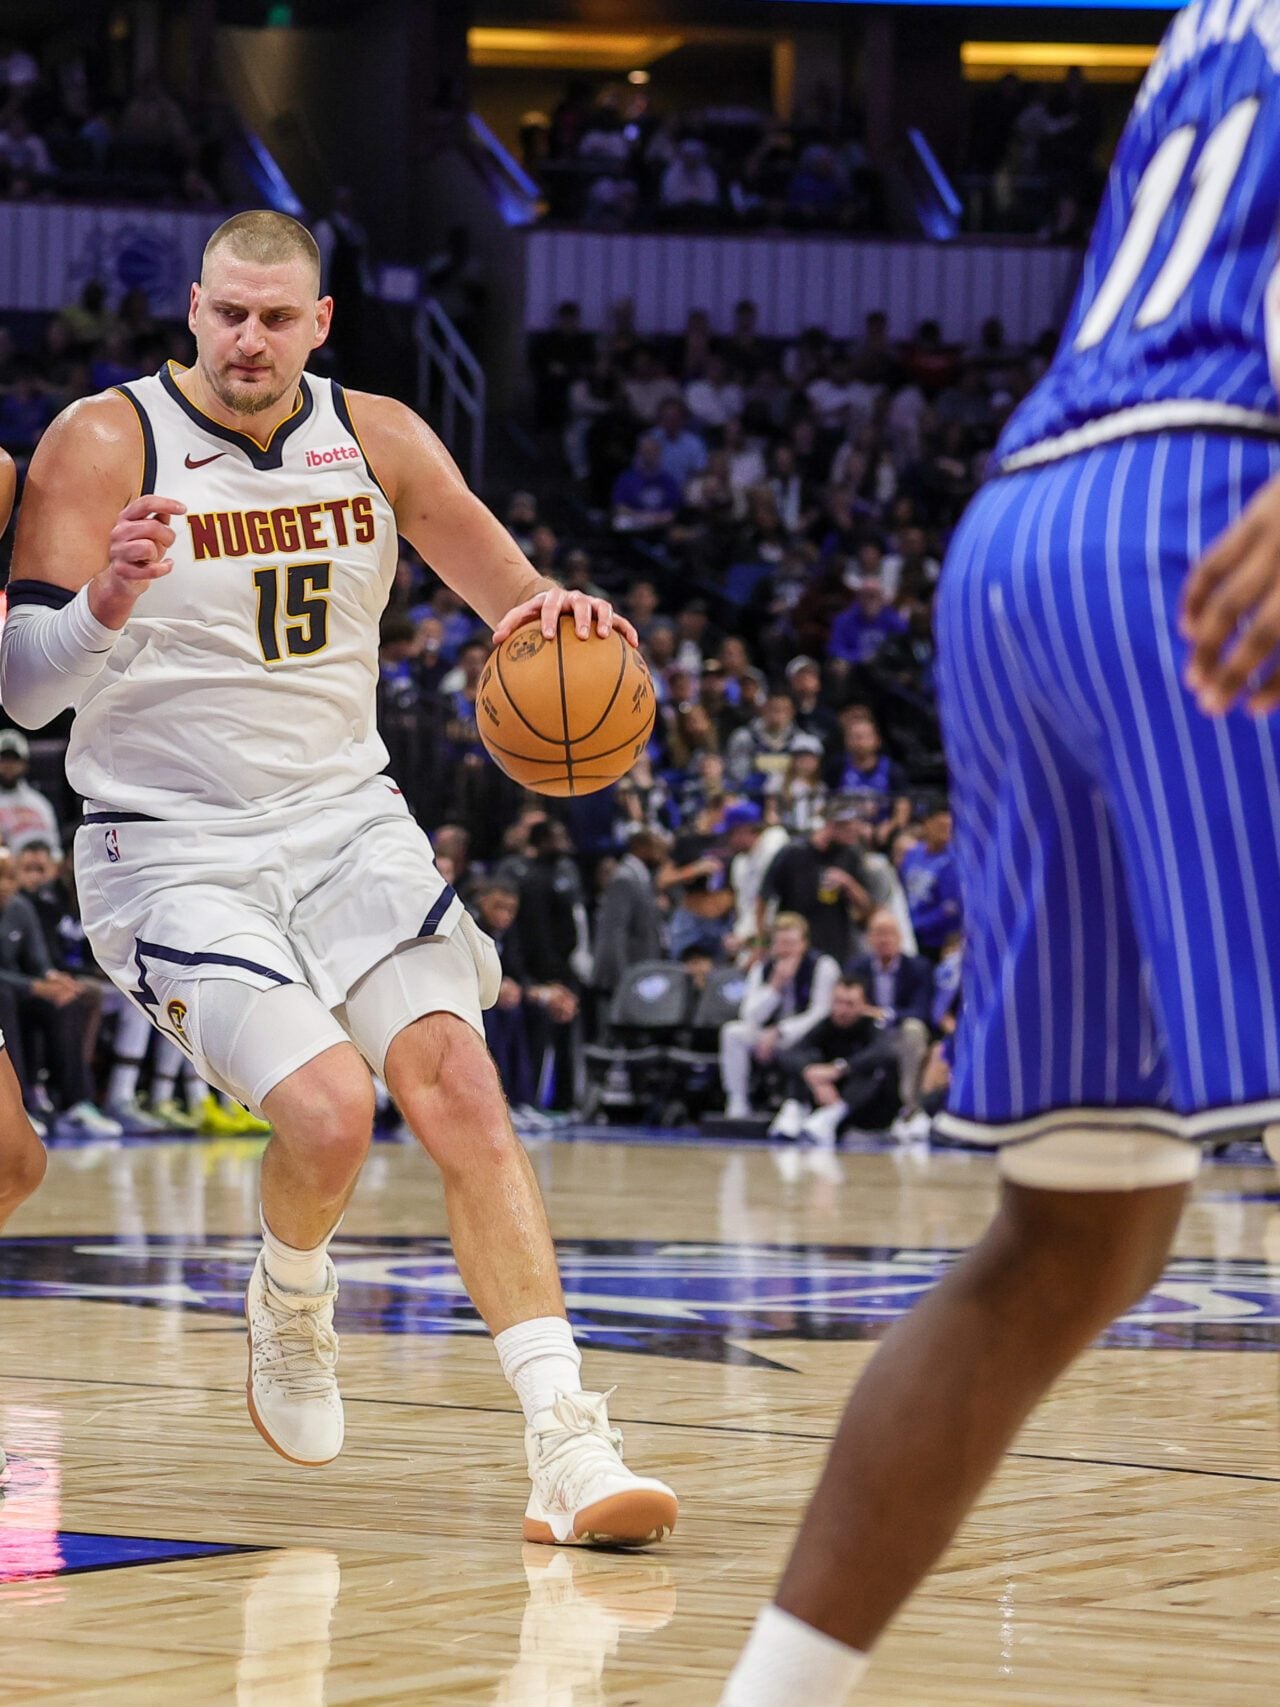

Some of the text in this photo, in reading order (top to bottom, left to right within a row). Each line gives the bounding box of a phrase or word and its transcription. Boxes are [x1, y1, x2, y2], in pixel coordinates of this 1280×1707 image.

[1072, 95, 1260, 353] 11
[306, 445, 359, 467] ibotta
[187, 496, 375, 561] NUGGETS
[252, 560, 332, 663] 15
